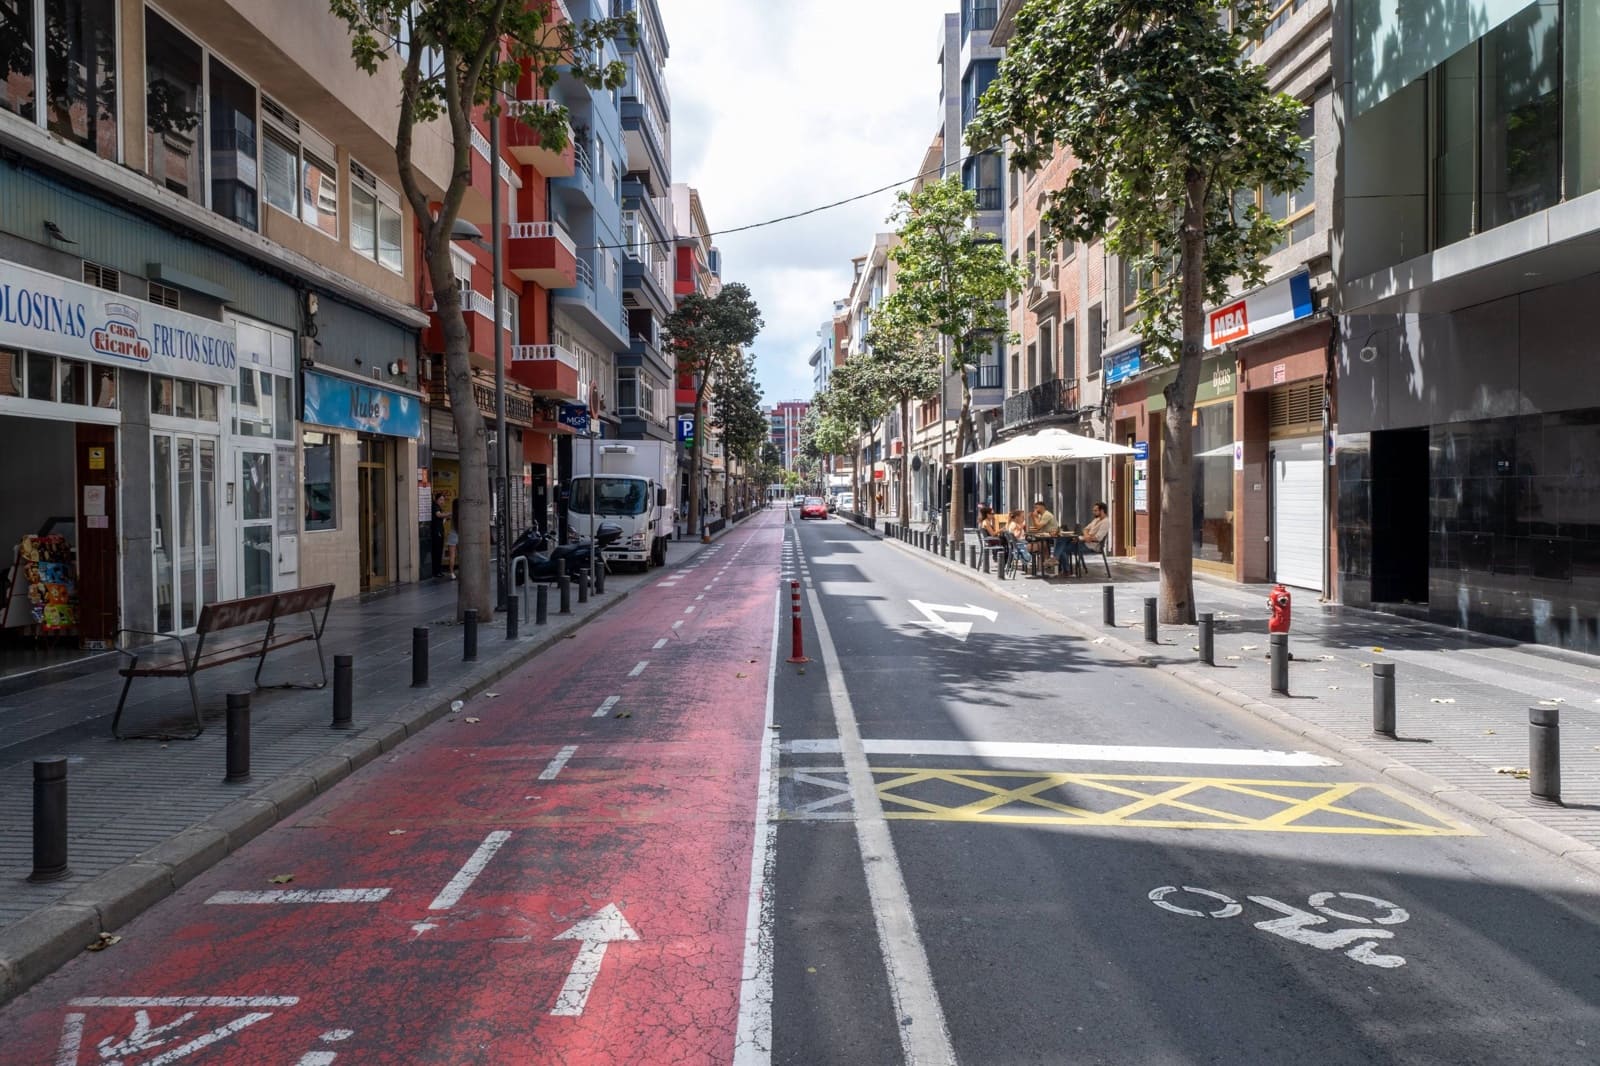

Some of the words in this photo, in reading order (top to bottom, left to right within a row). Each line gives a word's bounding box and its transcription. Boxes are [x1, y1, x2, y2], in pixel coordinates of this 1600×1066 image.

[0, 284, 86, 339] LOSINAS
[1213, 307, 1246, 341] MBA
[94, 331, 149, 360] Ricardo
[110, 323, 135, 339] casa
[153, 323, 200, 363] FRUTOS
[201, 335, 236, 370] SECOS
[348, 386, 380, 419] Nube
[566, 416, 586, 424] MGS
[683, 421, 693, 437] P
